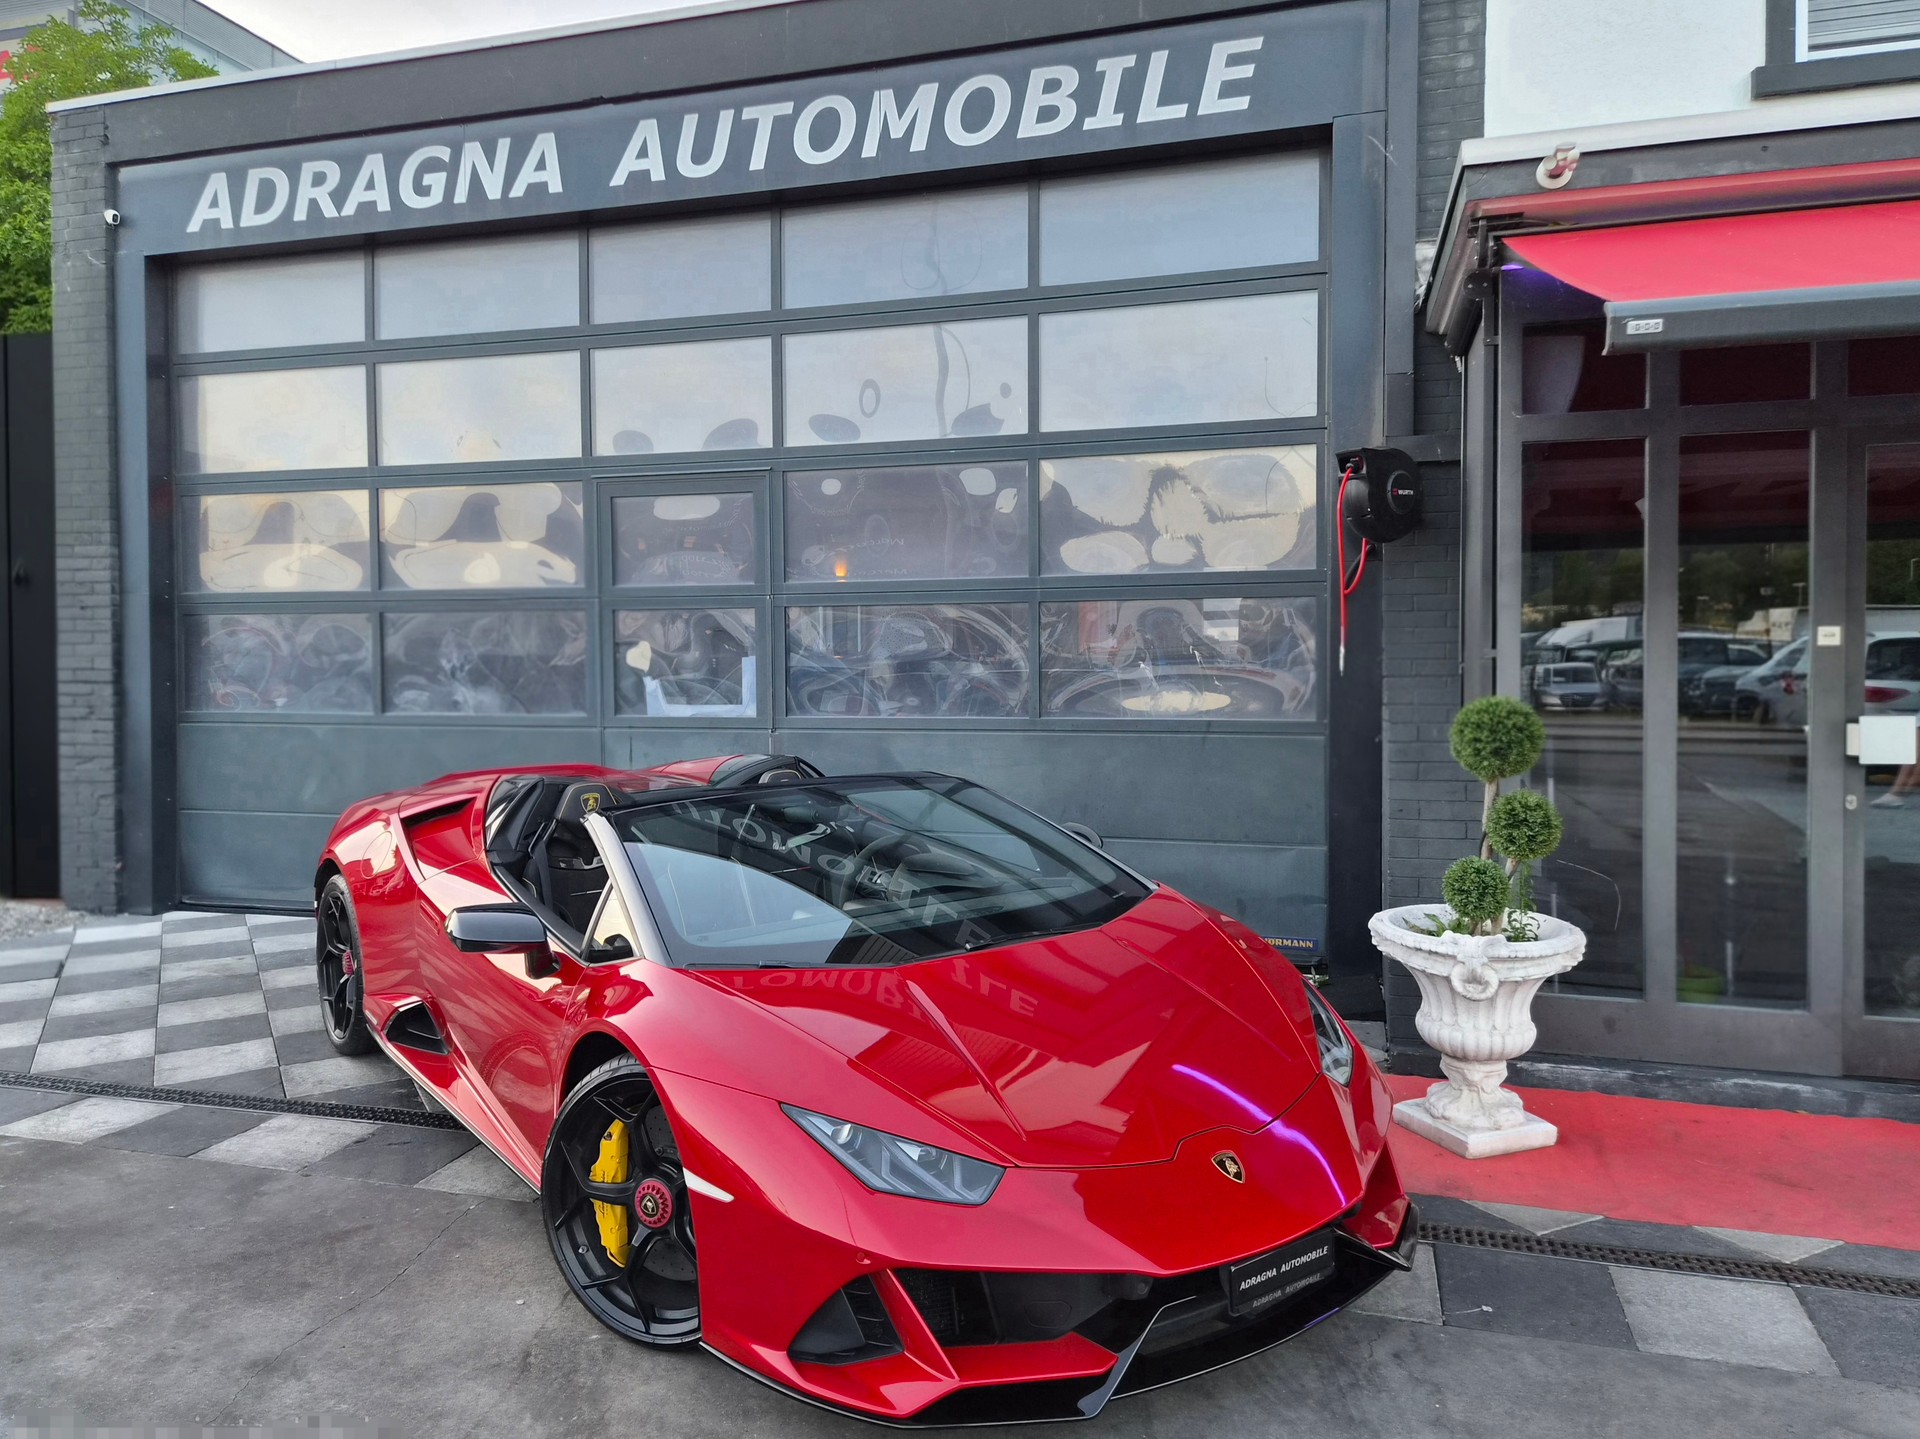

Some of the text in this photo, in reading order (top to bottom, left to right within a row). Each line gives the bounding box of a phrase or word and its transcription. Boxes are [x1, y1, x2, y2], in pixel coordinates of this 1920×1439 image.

[186, 36, 1264, 233] ADRAGNA AUTOMOBILE
[1239, 1245, 1329, 1291] ADRAGNA AUTOMOBILE
[1252, 1289, 1282, 1308] ADRAGNA
